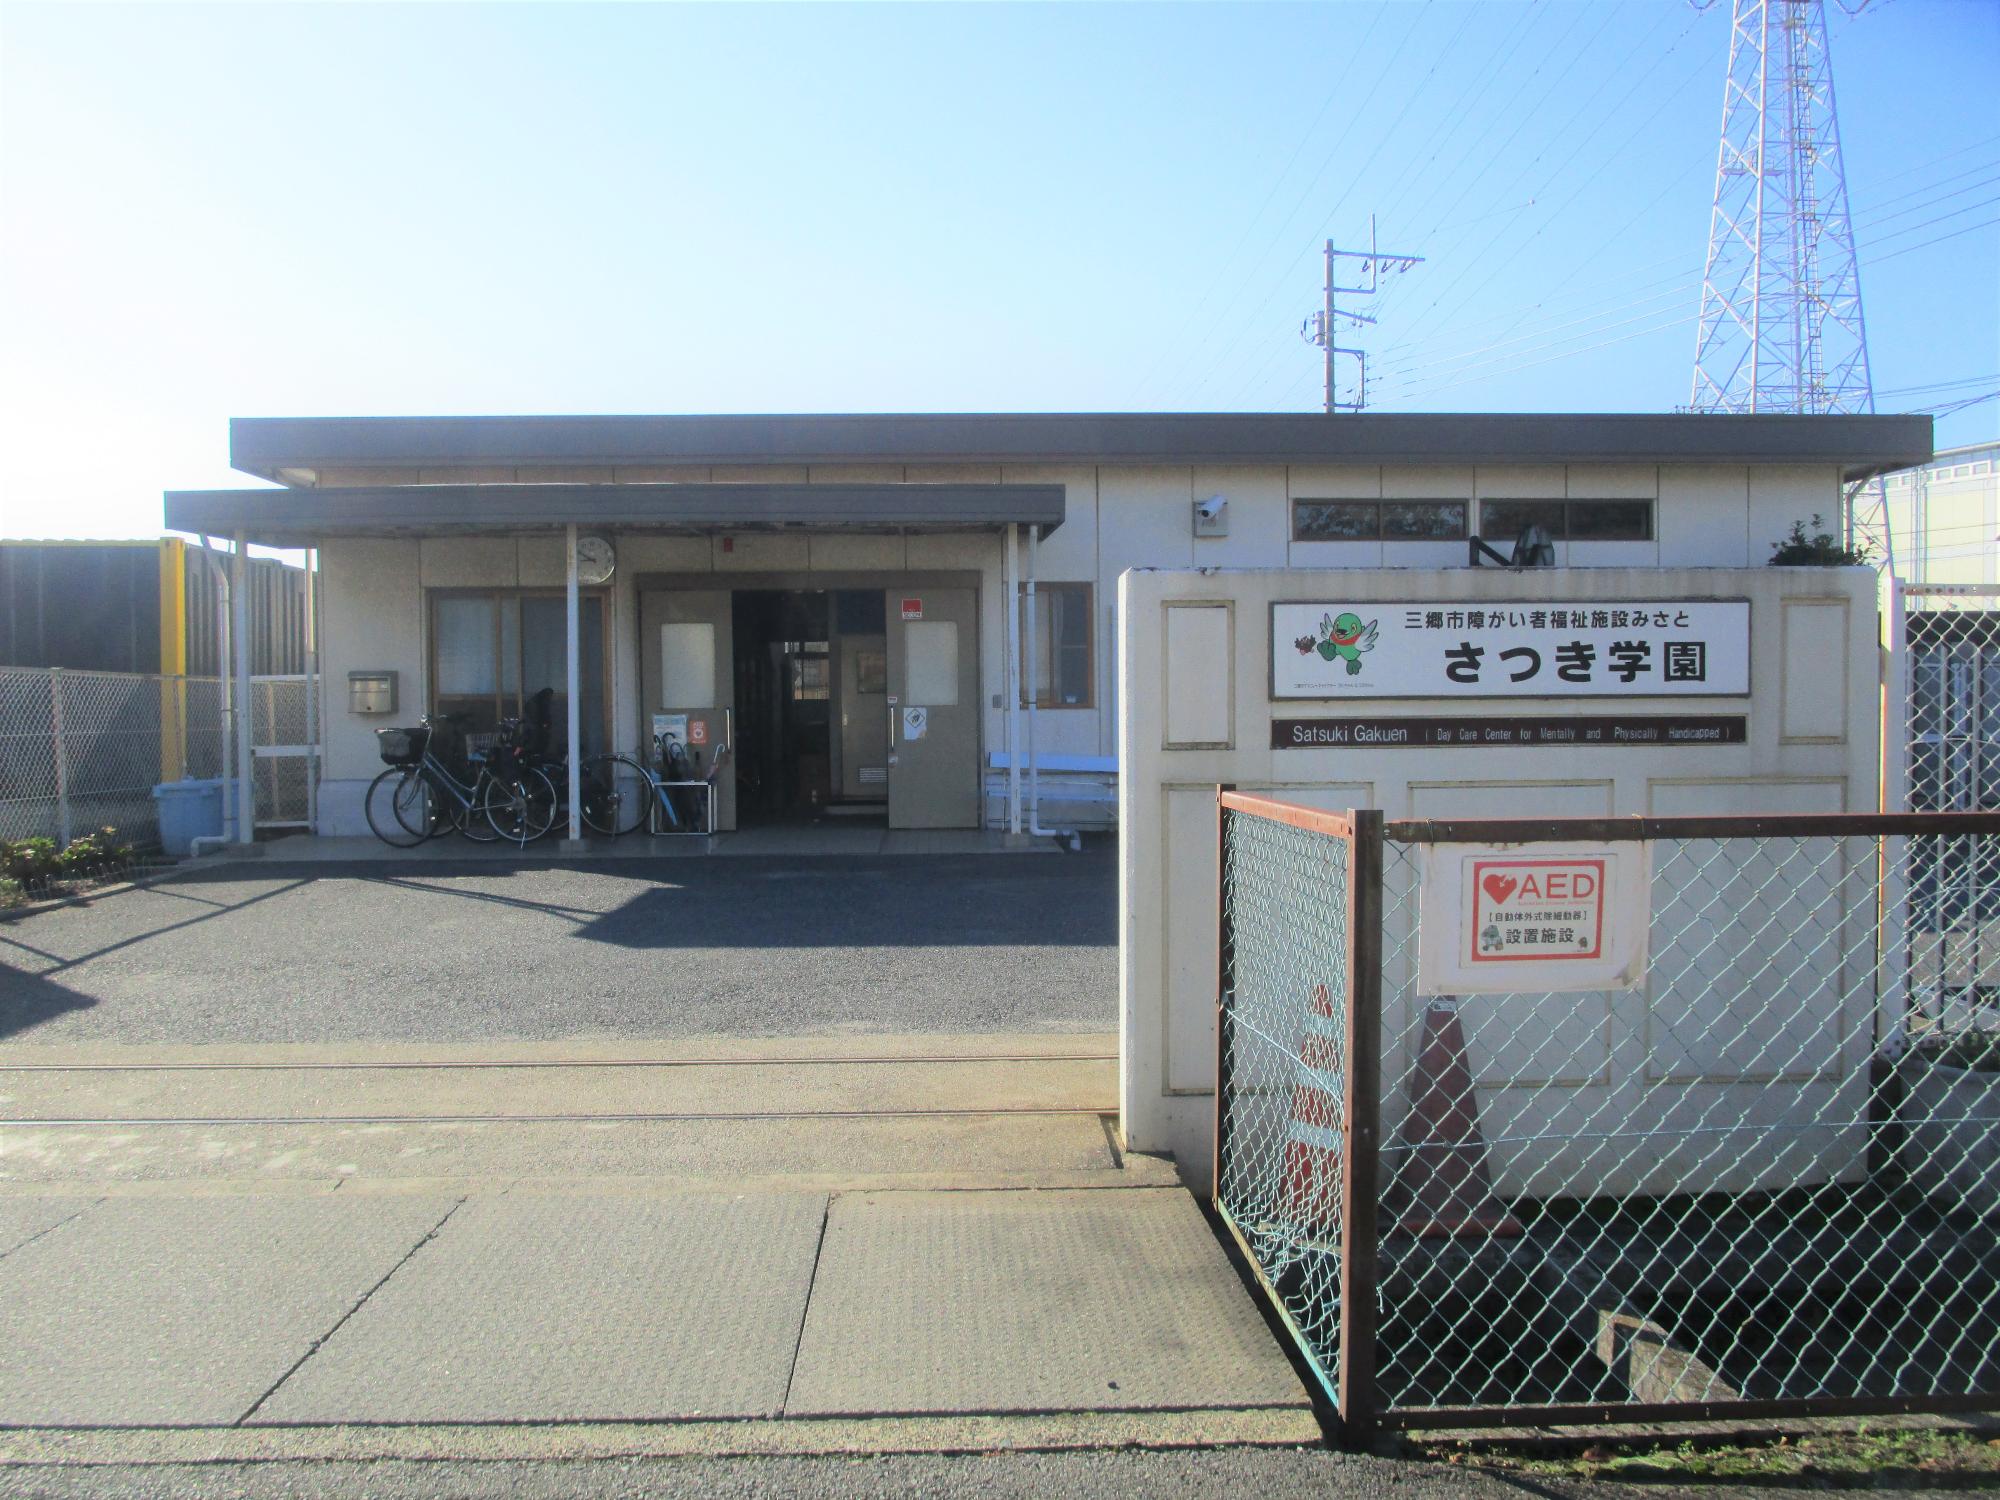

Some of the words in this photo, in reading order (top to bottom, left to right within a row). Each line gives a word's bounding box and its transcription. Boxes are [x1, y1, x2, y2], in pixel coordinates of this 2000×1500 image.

[1404, 610, 1689, 629] 三郷市障がい者福祉施設みさと
[1444, 640, 1706, 683] さつき学園
[1293, 725, 1348, 742] Satsuki
[1354, 725, 1407, 742] Gakuen
[1485, 728, 1512, 741] Center
[1518, 873, 1595, 899] AED
[1505, 927, 1574, 944] 設置施設
